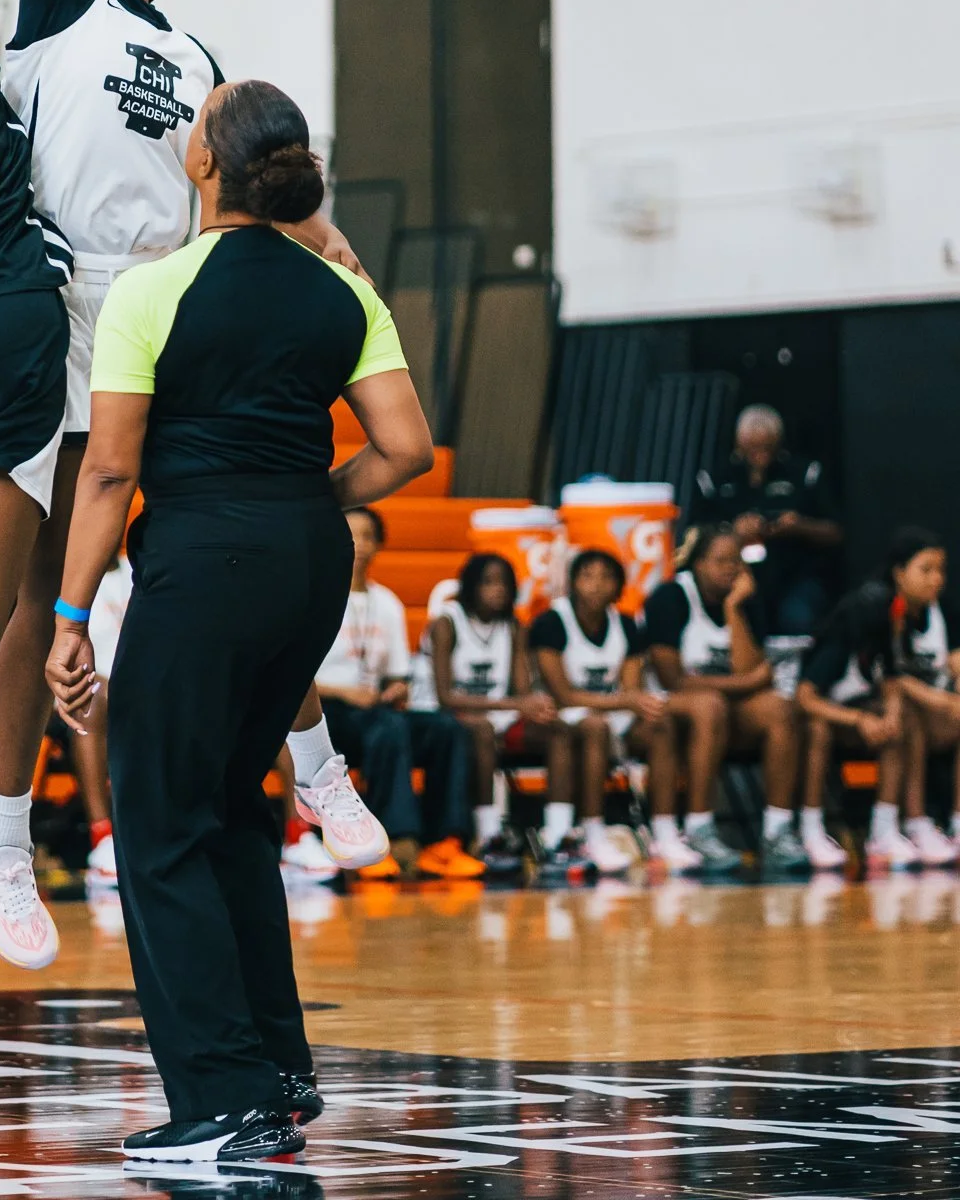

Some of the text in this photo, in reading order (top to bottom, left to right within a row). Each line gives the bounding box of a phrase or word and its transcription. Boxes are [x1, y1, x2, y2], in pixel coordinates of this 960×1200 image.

[139, 64, 171, 93] CHI
[118, 80, 184, 117] BASKETBALL
[121, 99, 176, 127] ACADEMY
